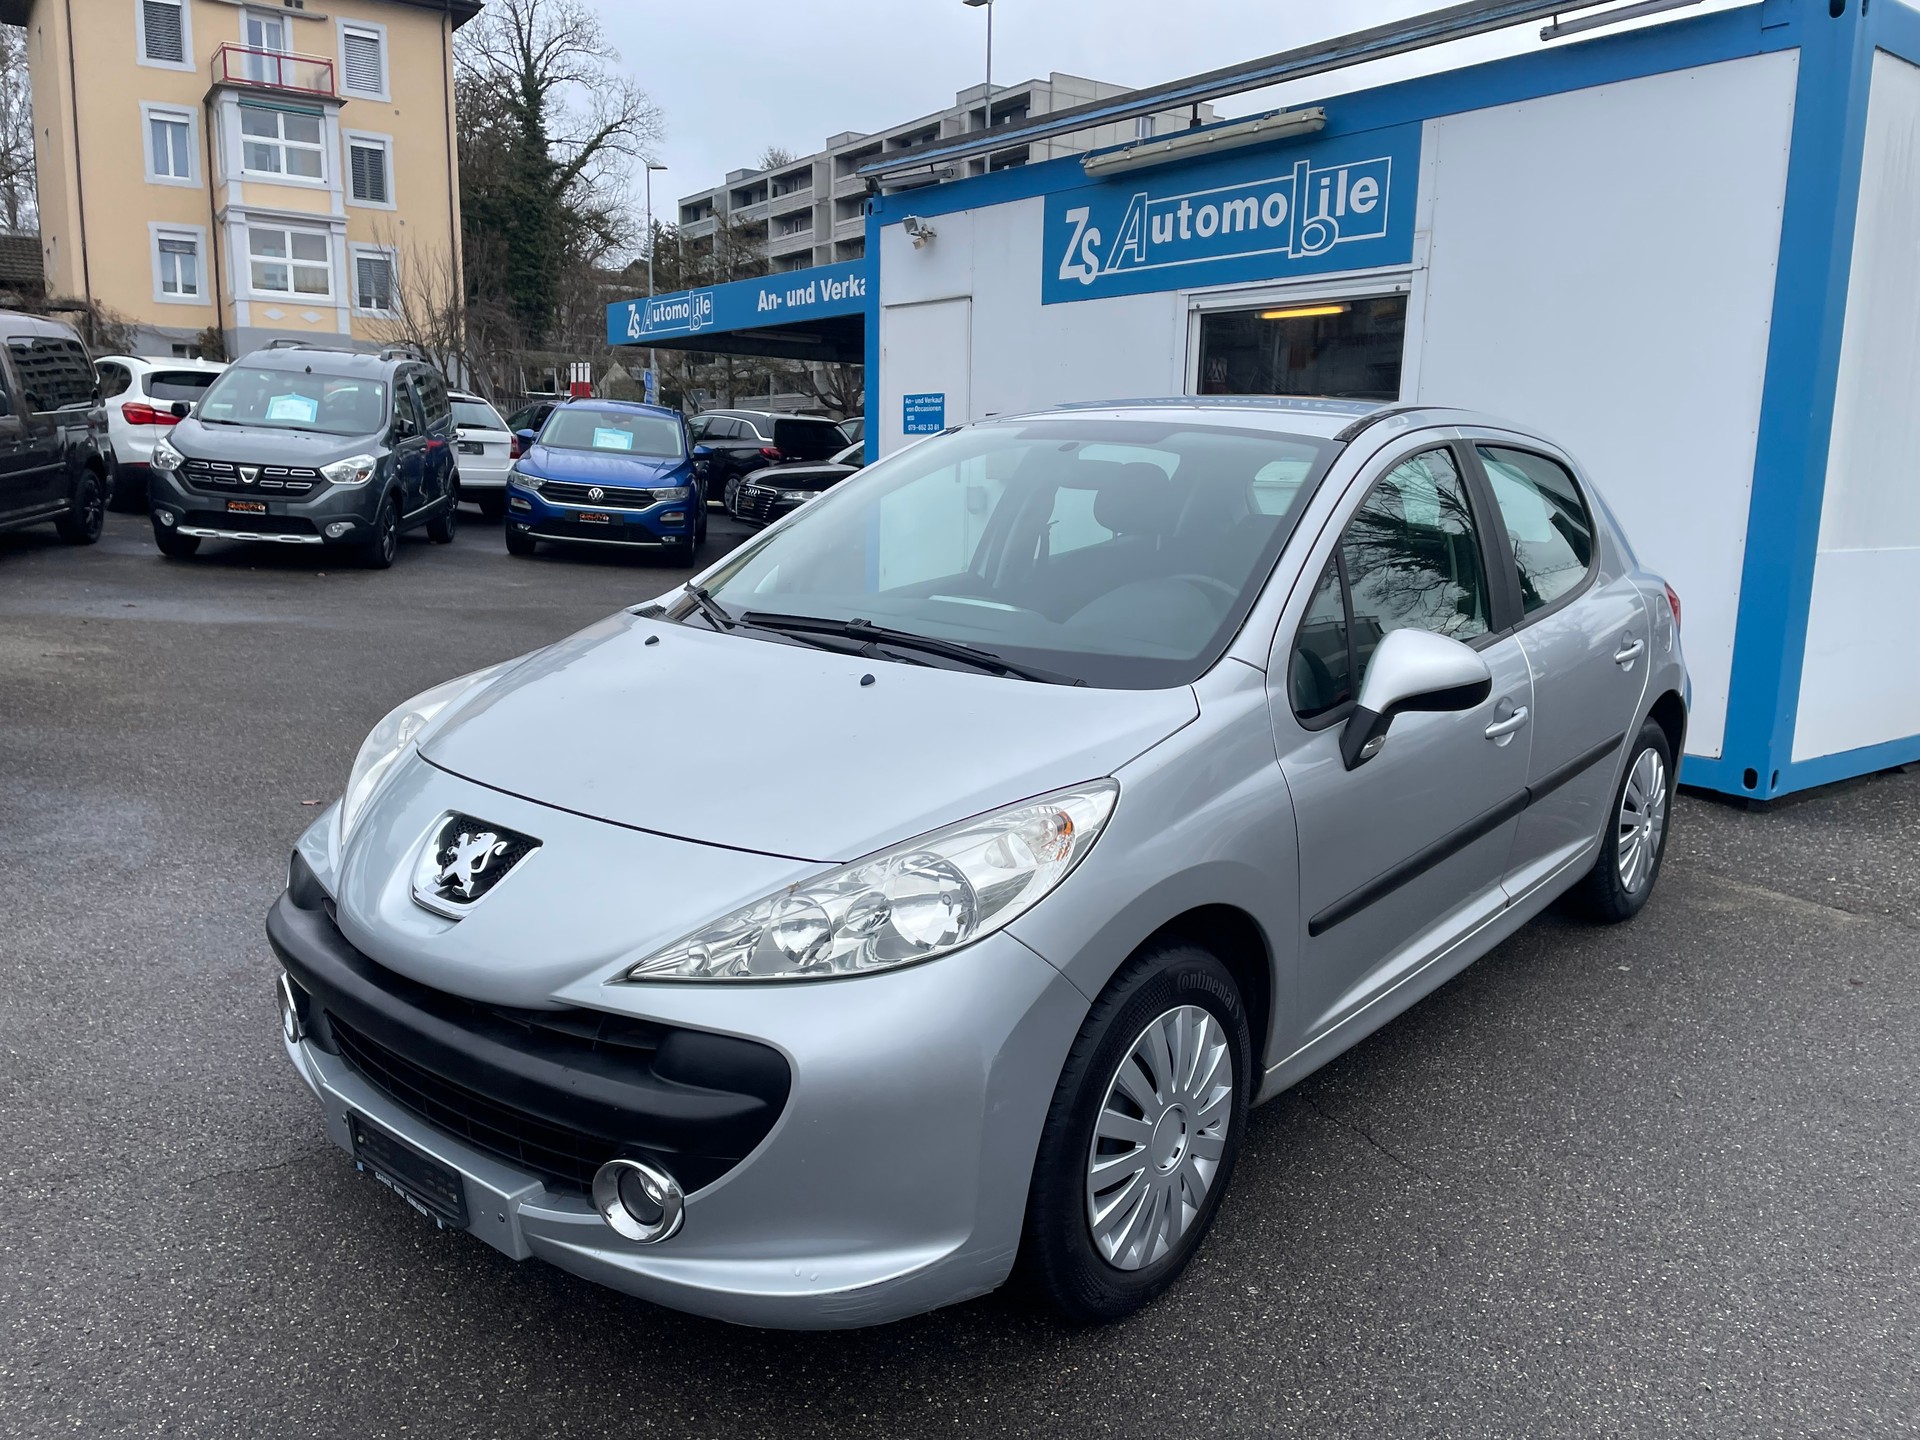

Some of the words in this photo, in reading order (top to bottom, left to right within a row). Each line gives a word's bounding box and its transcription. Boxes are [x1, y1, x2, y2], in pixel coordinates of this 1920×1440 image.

[1104, 160, 1380, 271] Automobile
[641, 290, 711, 334] Automobile
[757, 289, 783, 312] An-
[786, 280, 816, 307] und
[924, 396, 943, 404] Verkauf
[1177, 969, 1236, 1012] Continental
